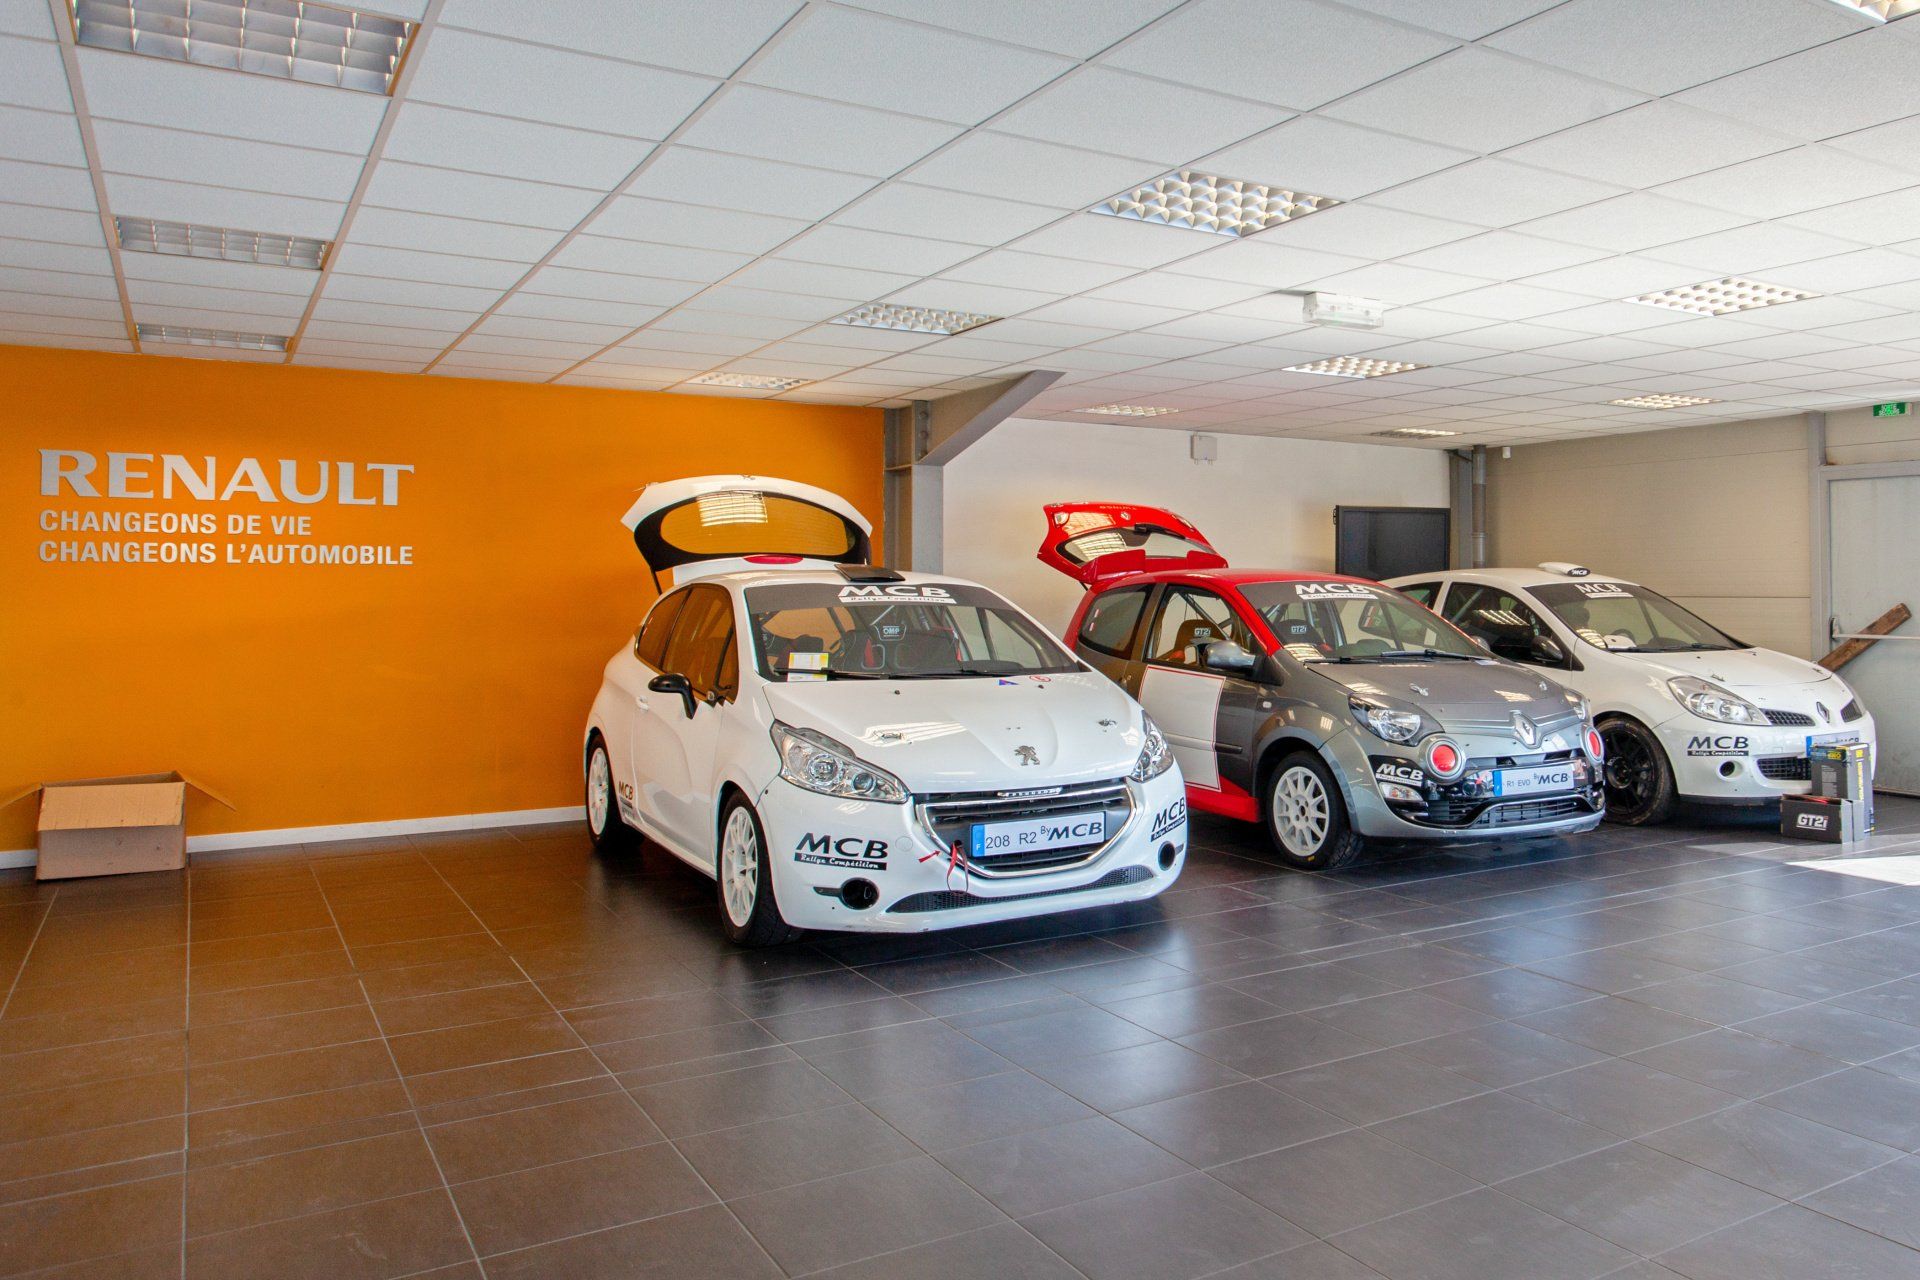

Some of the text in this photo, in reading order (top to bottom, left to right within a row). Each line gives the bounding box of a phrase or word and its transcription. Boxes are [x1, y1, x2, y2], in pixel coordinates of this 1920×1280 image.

[38, 448, 415, 506] RENAULT
[39, 509, 312, 536] CHANGEONS DE VIE
[39, 540, 413, 565] CHANGEONS L'AUTOMOBILE
[838, 585, 951, 598] MCB
[1295, 583, 1371, 595] MCB
[1575, 584, 1622, 593] MCB
[883, 627, 900, 635] OMP
[1688, 736, 1749, 749] MCB
[1375, 763, 1424, 780] MCB
[1518, 779, 1531, 787] EVO
[1538, 773, 1569, 785] MCB
[618, 780, 634, 801] MCB
[1151, 796, 1186, 833] MCB
[1796, 813, 1829, 829] GT2i
[985, 821, 1103, 849] 208 R2 By MCB
[795, 832, 889, 859] MCB
